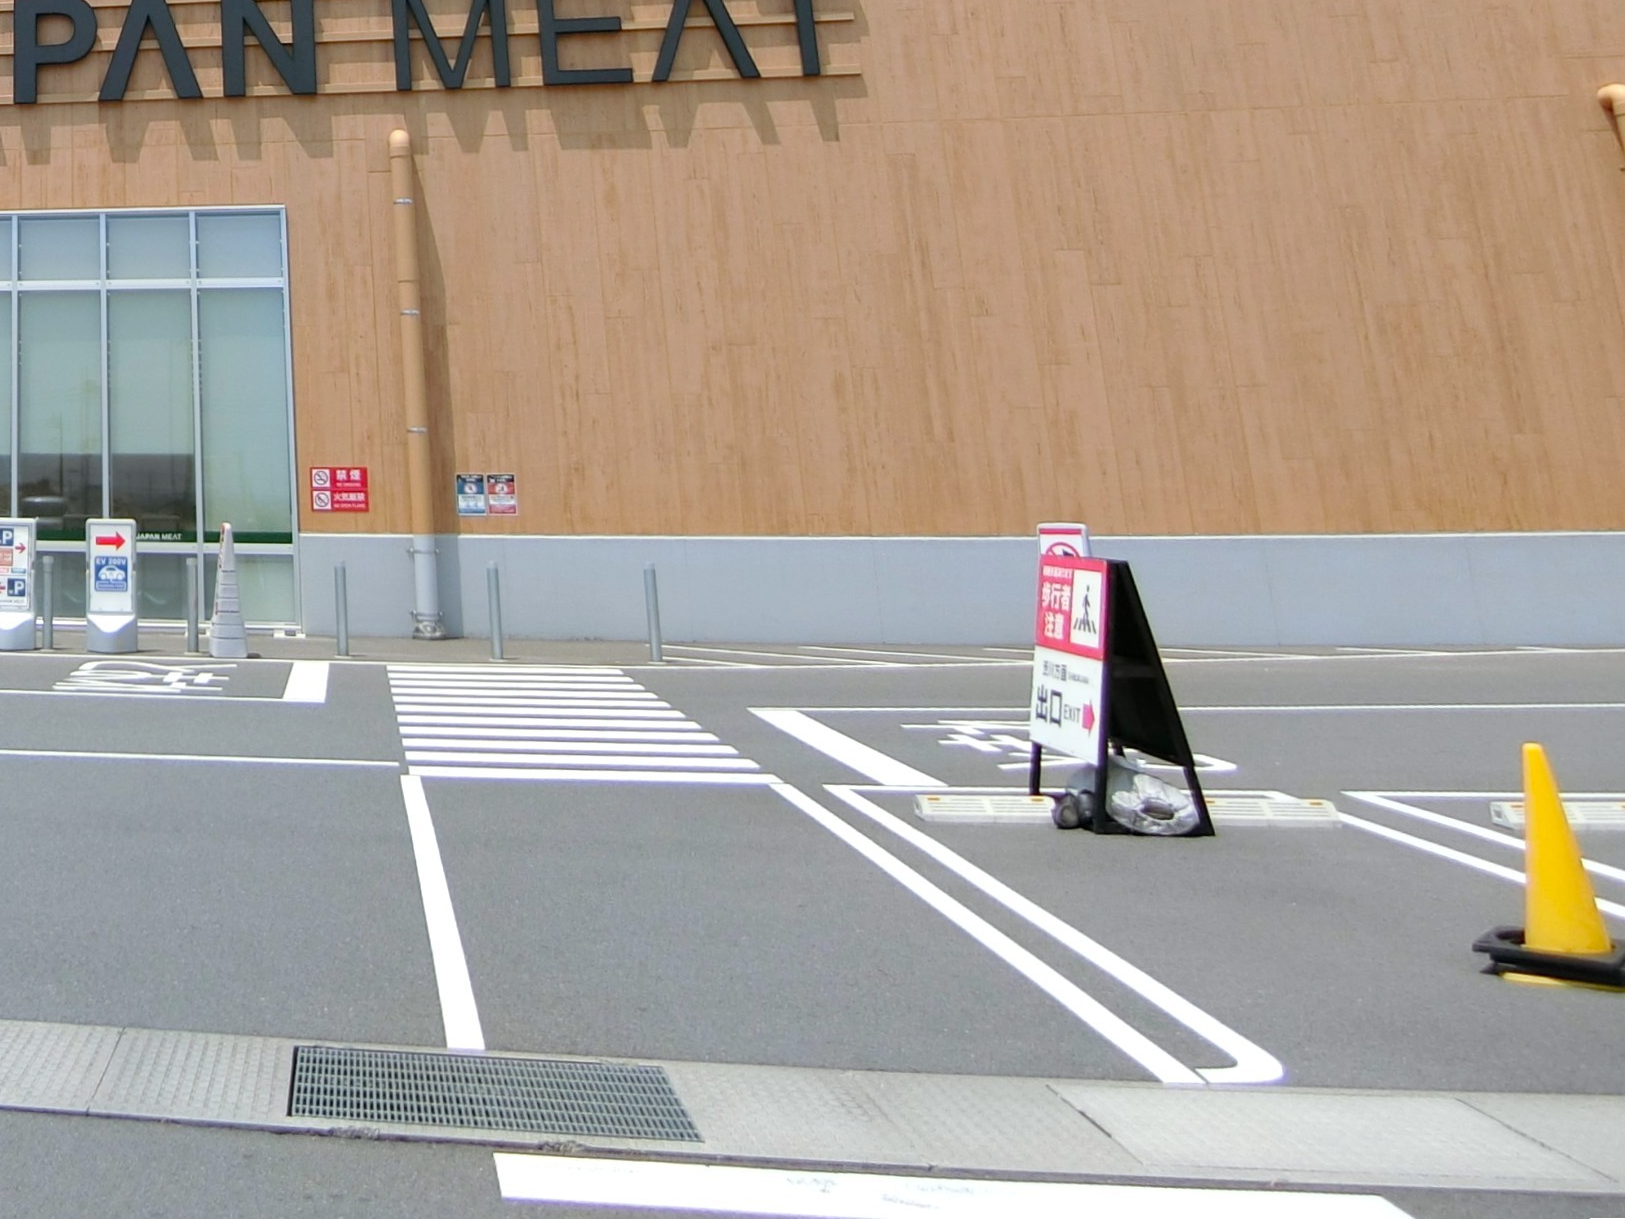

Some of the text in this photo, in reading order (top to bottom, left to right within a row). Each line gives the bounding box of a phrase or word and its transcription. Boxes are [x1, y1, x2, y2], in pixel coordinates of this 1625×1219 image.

[336, 469, 361, 481] 禁煙
[333, 492, 366, 502] 火気厳禁
[161, 533, 182, 541] MEAT
[1041, 581, 1072, 612] 歩行者
[1044, 611, 1065, 640] 注意
[1035, 684, 1081, 729] 出口 EXIT
